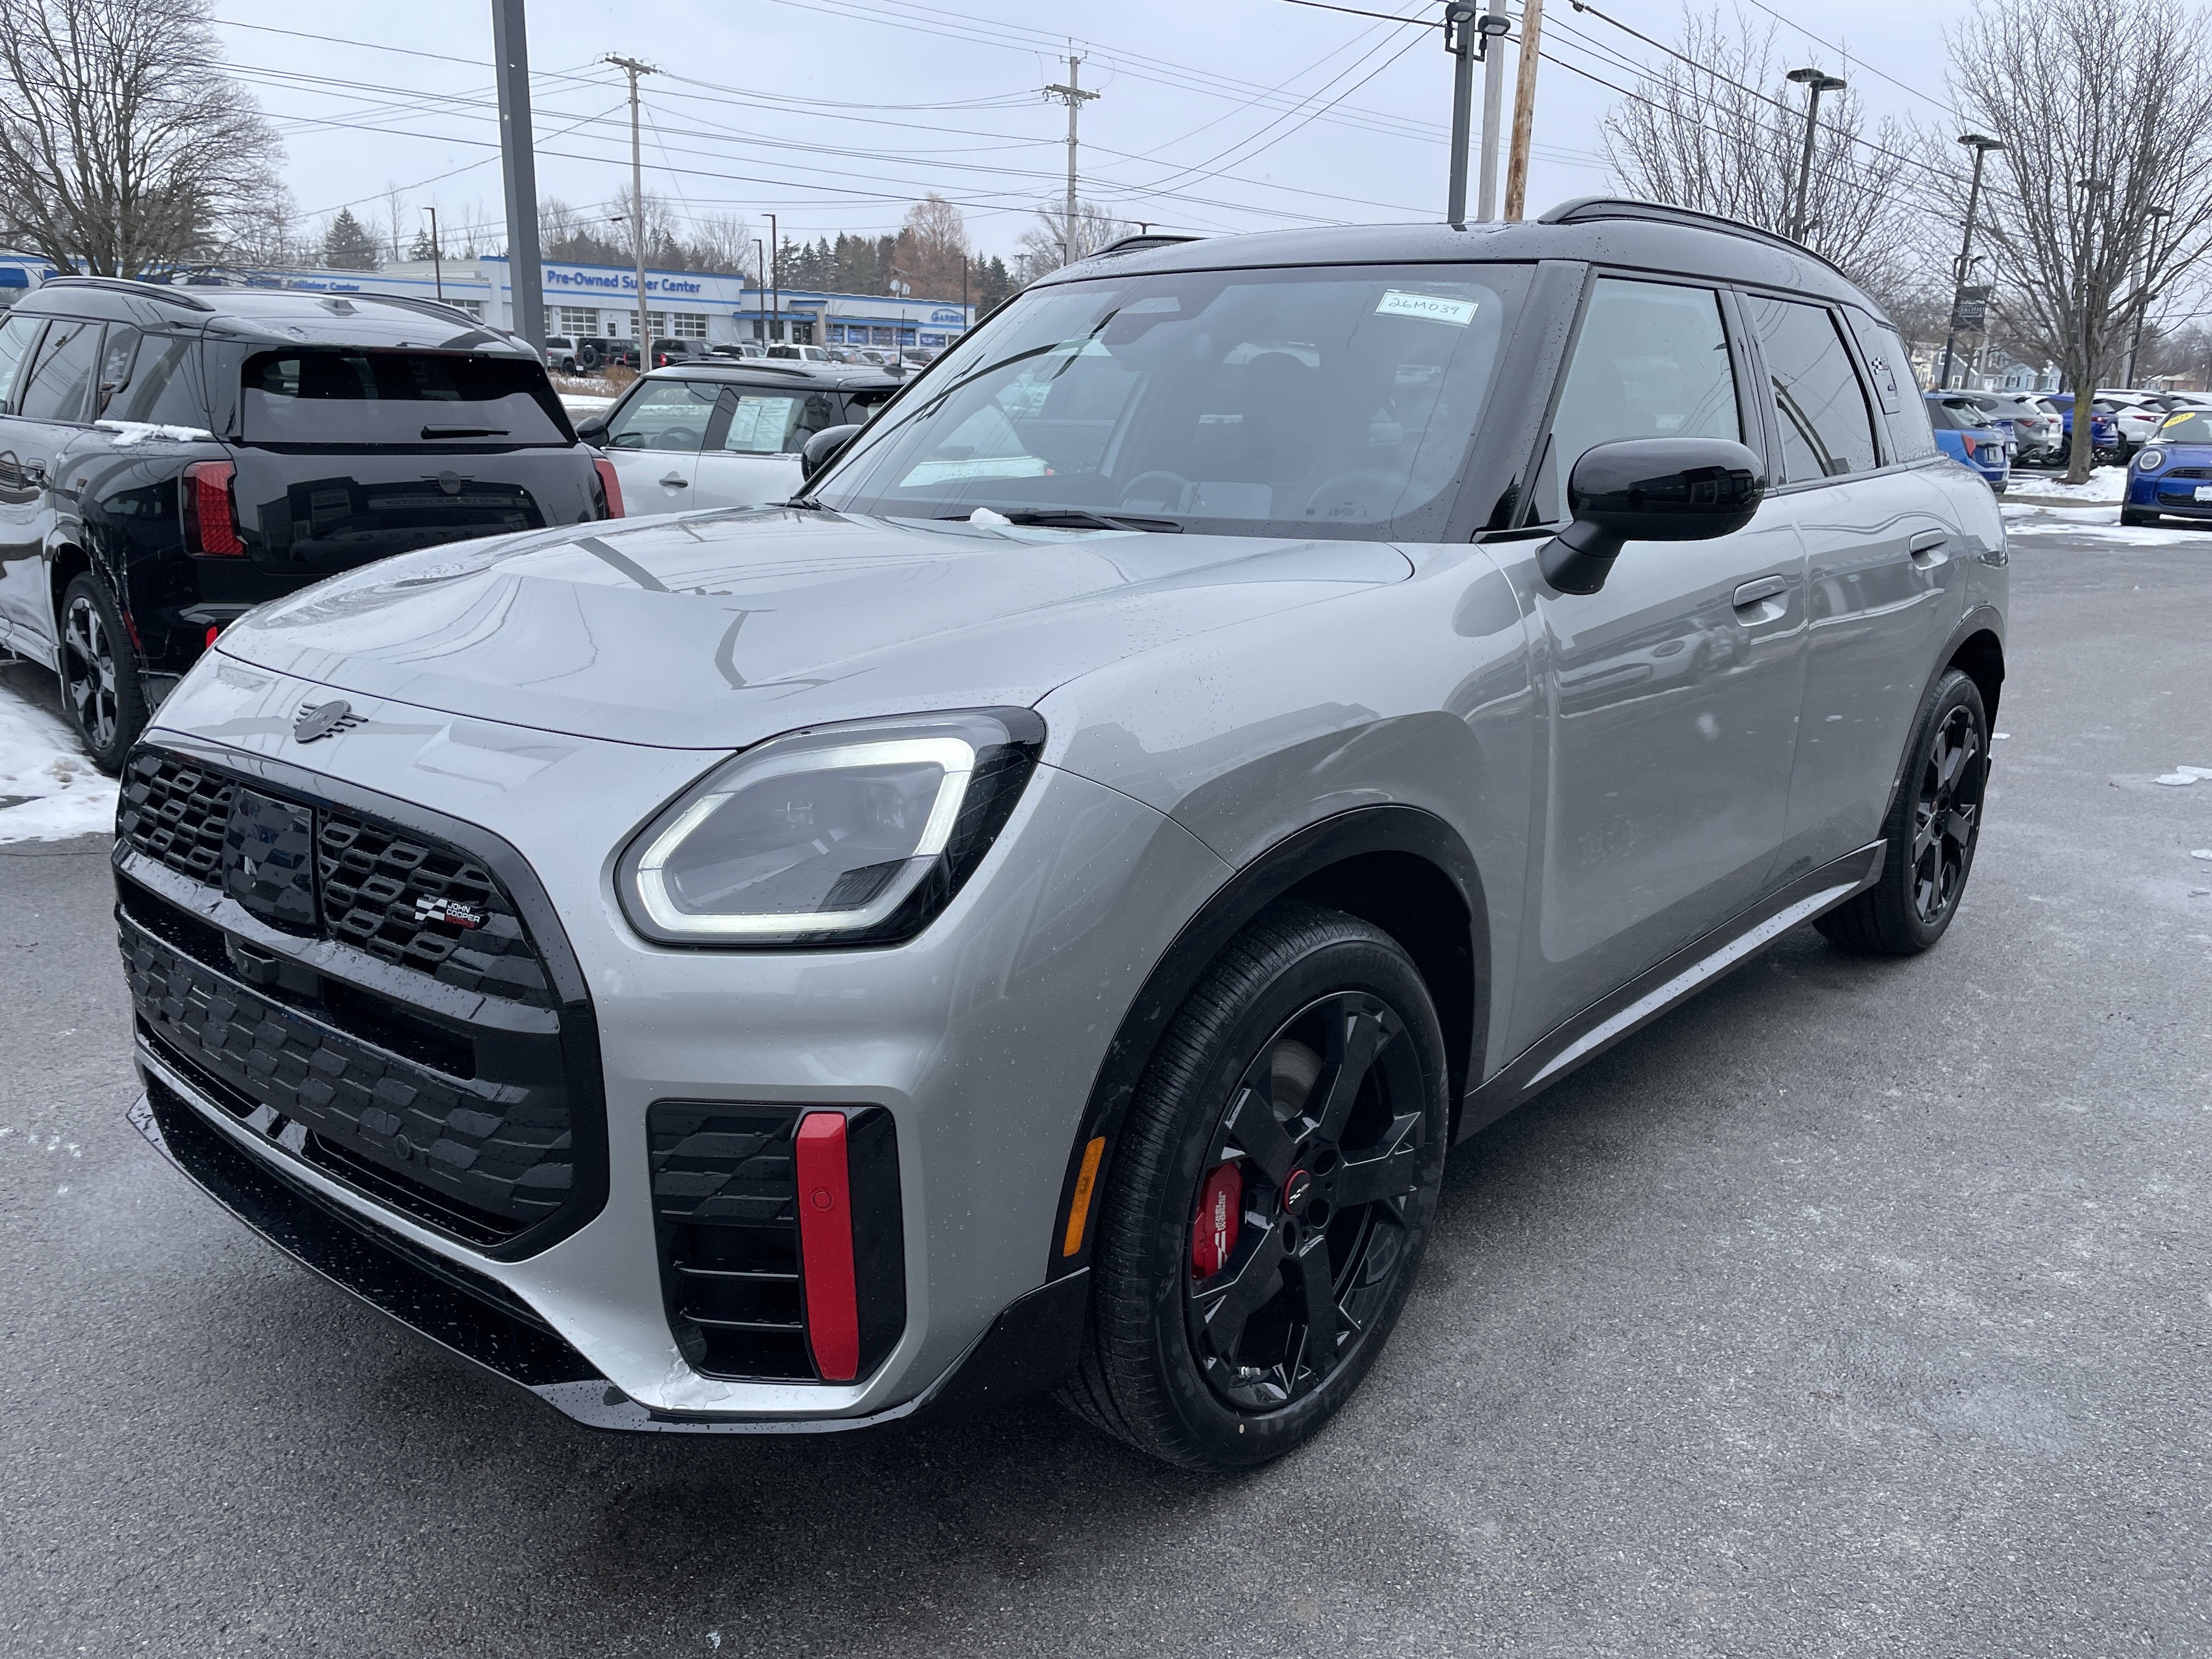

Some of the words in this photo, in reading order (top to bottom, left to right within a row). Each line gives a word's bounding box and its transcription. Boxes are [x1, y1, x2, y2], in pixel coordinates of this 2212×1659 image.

[547, 270, 619, 287] Pre-Owned
[623, 276, 658, 290] Suer
[662, 279, 701, 293] Center
[1388, 297, 1460, 315] 26M039
[448, 902, 470, 913] JOHN
[445, 916, 476, 929] WORKS
[447, 909, 480, 923] COOPER
